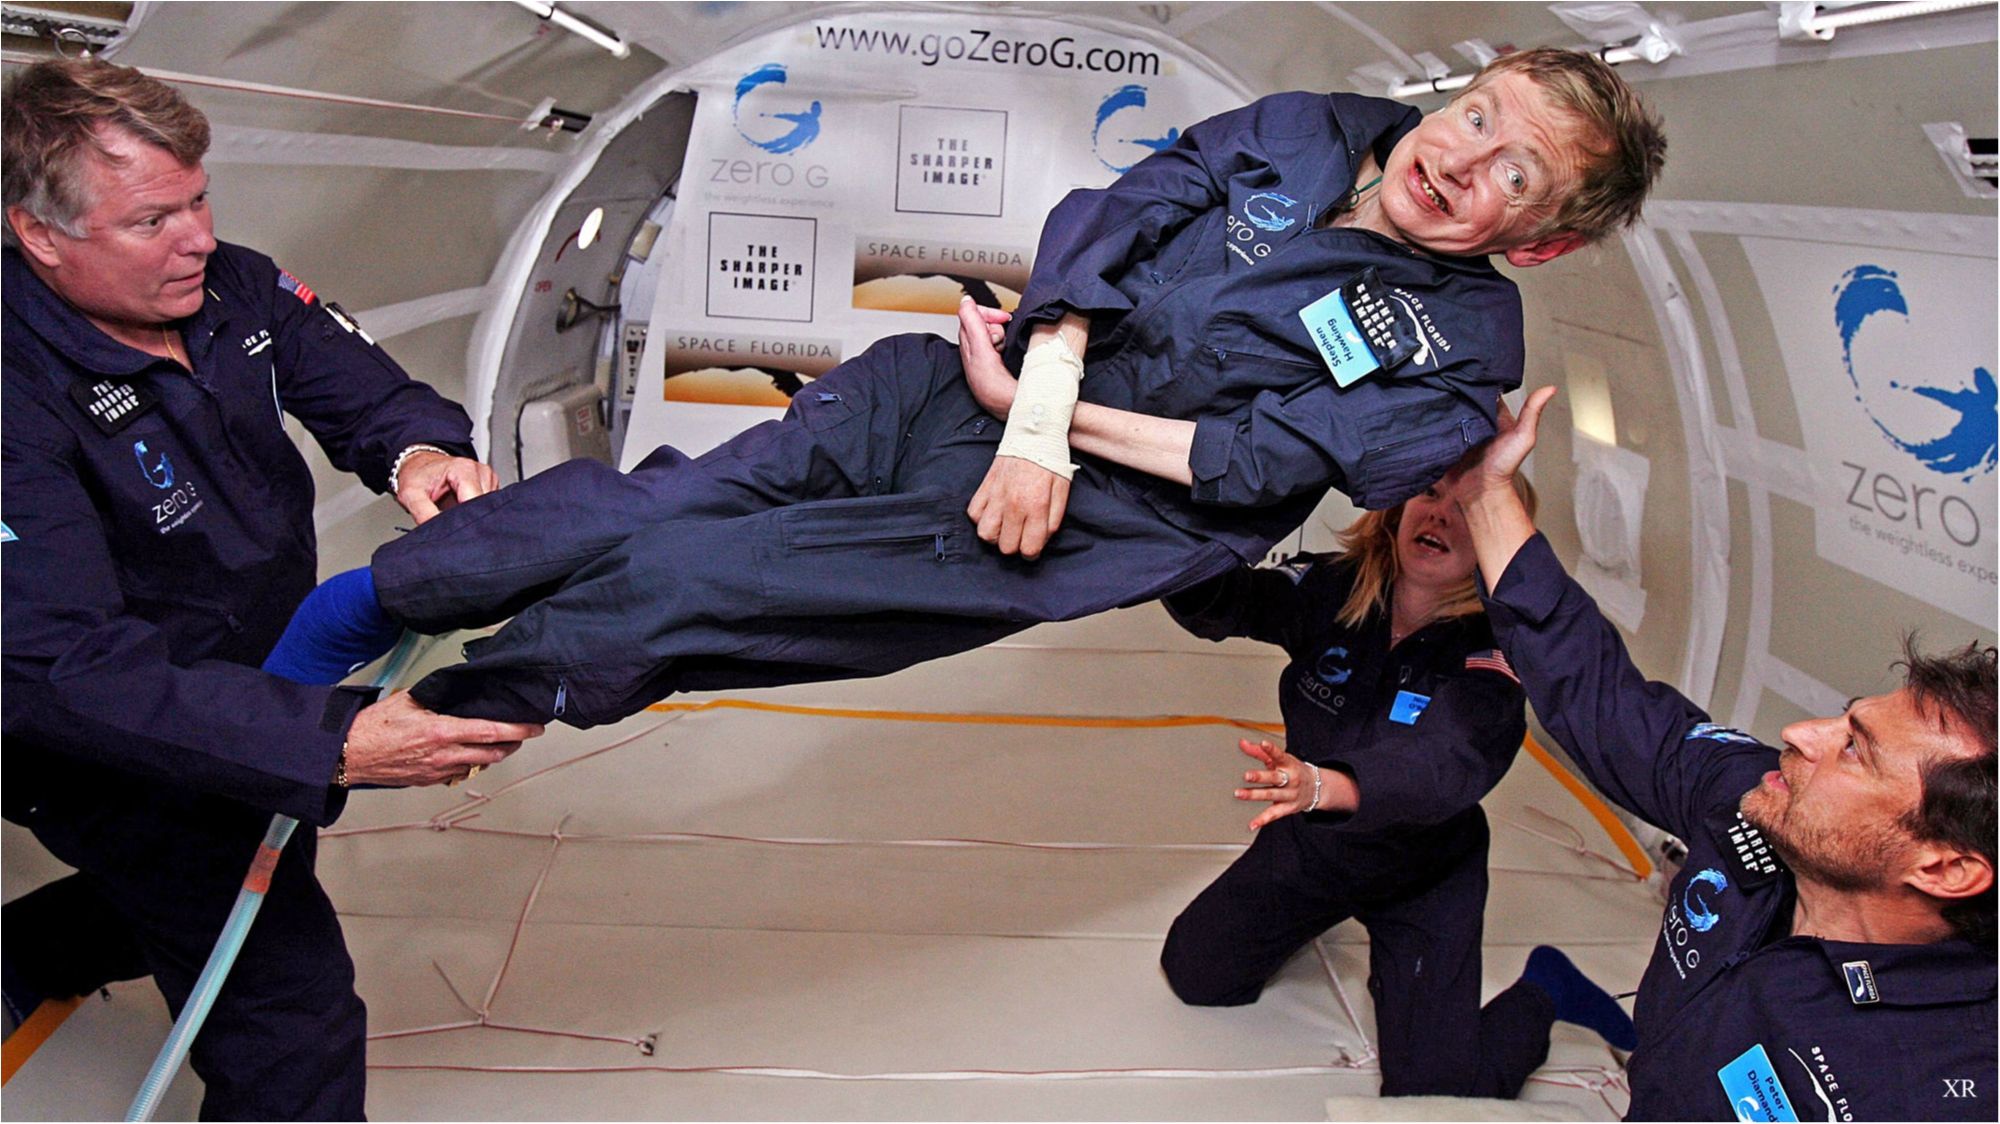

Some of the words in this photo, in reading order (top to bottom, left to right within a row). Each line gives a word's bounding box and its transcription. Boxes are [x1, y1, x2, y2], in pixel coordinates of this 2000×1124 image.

[816, 25, 1160, 76] www.goZeroG.com
[937, 138, 968, 151] THE
[710, 158, 795, 187] zero
[806, 165, 829, 188] G
[910, 153, 993, 170] SHARPER
[923, 170, 979, 186] IMAGE
[1226, 215, 1254, 242] ero
[747, 244, 778, 258] THE
[868, 242, 927, 260] SPACE
[940, 247, 1023, 266] FLORIDA
[720, 259, 802, 276] SHARPER
[734, 276, 789, 292] IMAGE
[1352, 299, 1383, 347] IMAGE
[1356, 283, 1398, 350] SHARPER
[1375, 298, 1396, 326] THE
[678, 336, 737, 354] SPACE
[751, 340, 833, 358] FLORIDA
[1316, 326, 1342, 368] Stephen
[1327, 318, 1354, 362] Hawking
[1421, 313, 1452, 353] FLORIDA
[1842, 460, 1981, 548] zero
[1875, 528, 1954, 568] weightless
[1811, 1046, 1839, 1093] SPACE
[1747, 1070, 1779, 1122] Diamand
[1765, 1076, 1785, 1111] Peter
